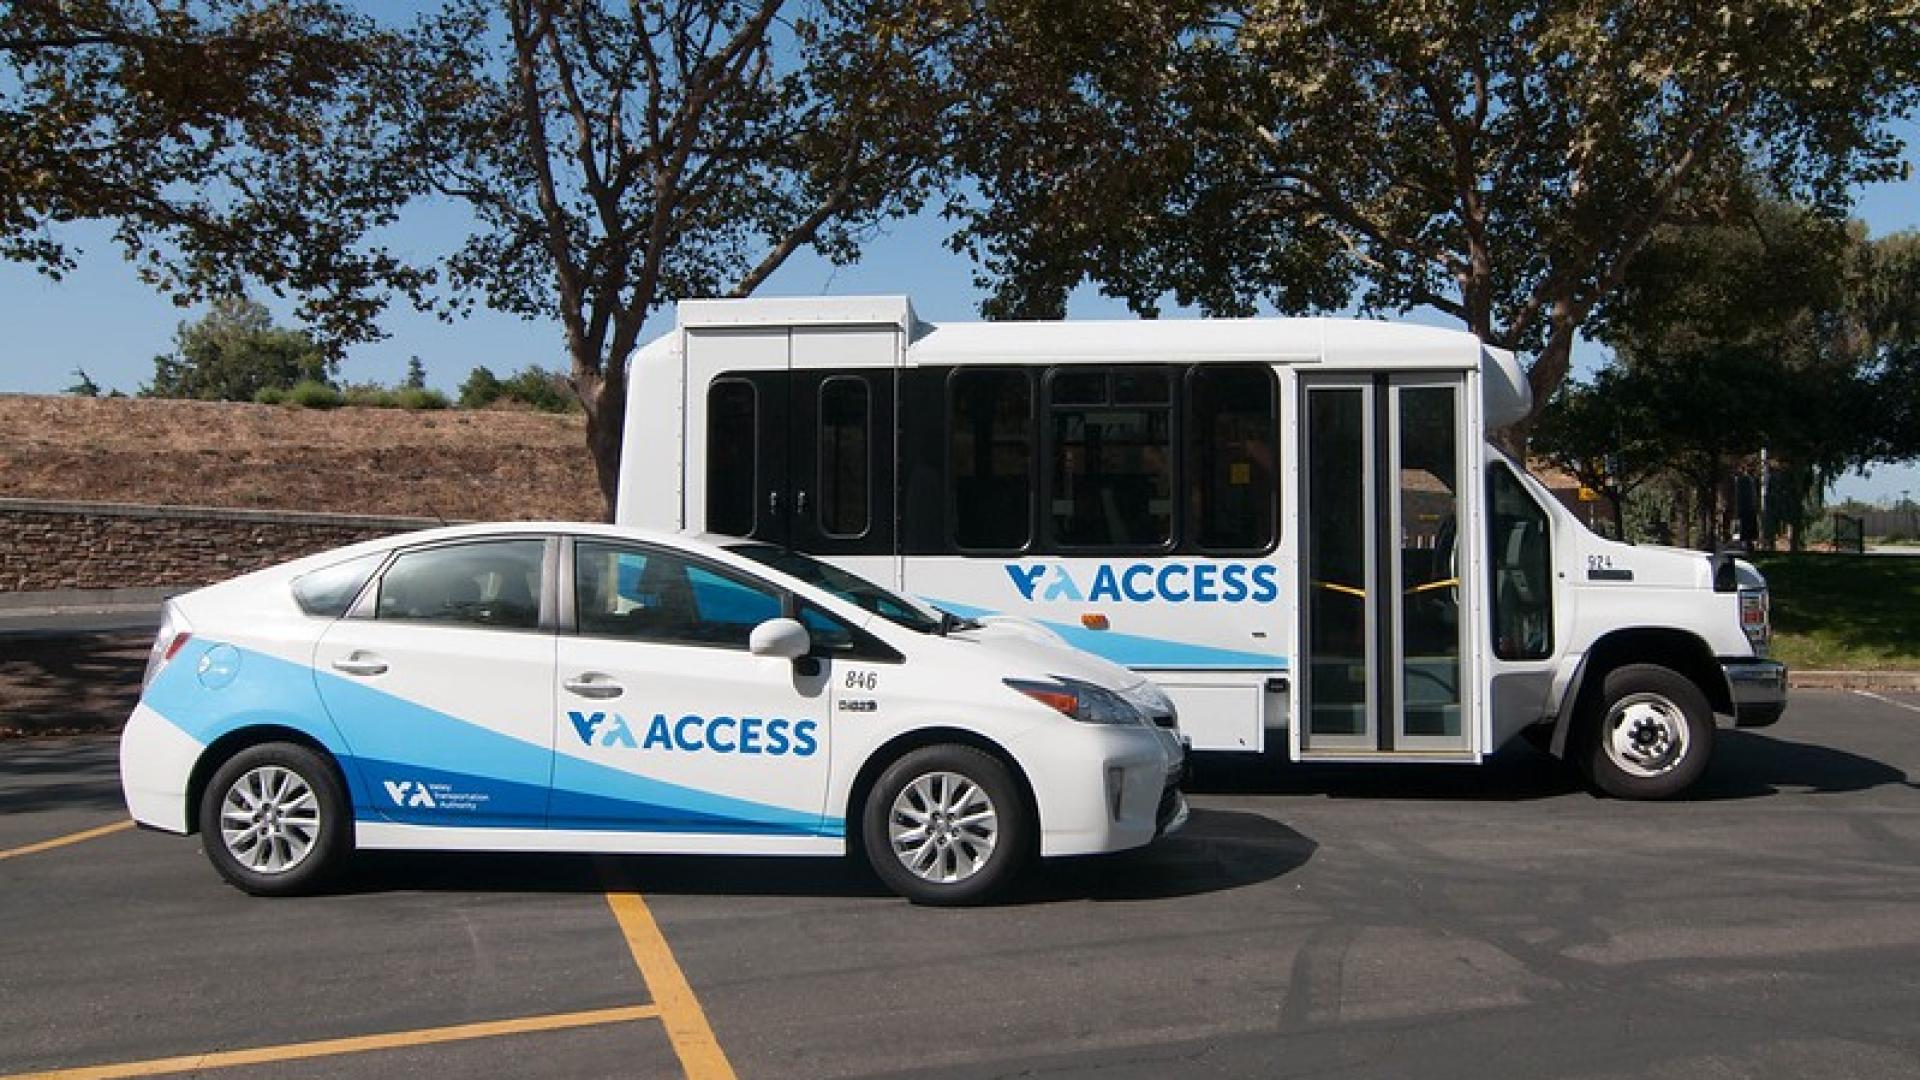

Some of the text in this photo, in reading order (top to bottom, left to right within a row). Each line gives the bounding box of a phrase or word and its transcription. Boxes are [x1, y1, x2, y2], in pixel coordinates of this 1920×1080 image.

[1588, 555, 1612, 570] 924
[1089, 563, 1278, 602] ACCESS
[846, 670, 877, 690] 846
[643, 713, 818, 756] ACCESS
